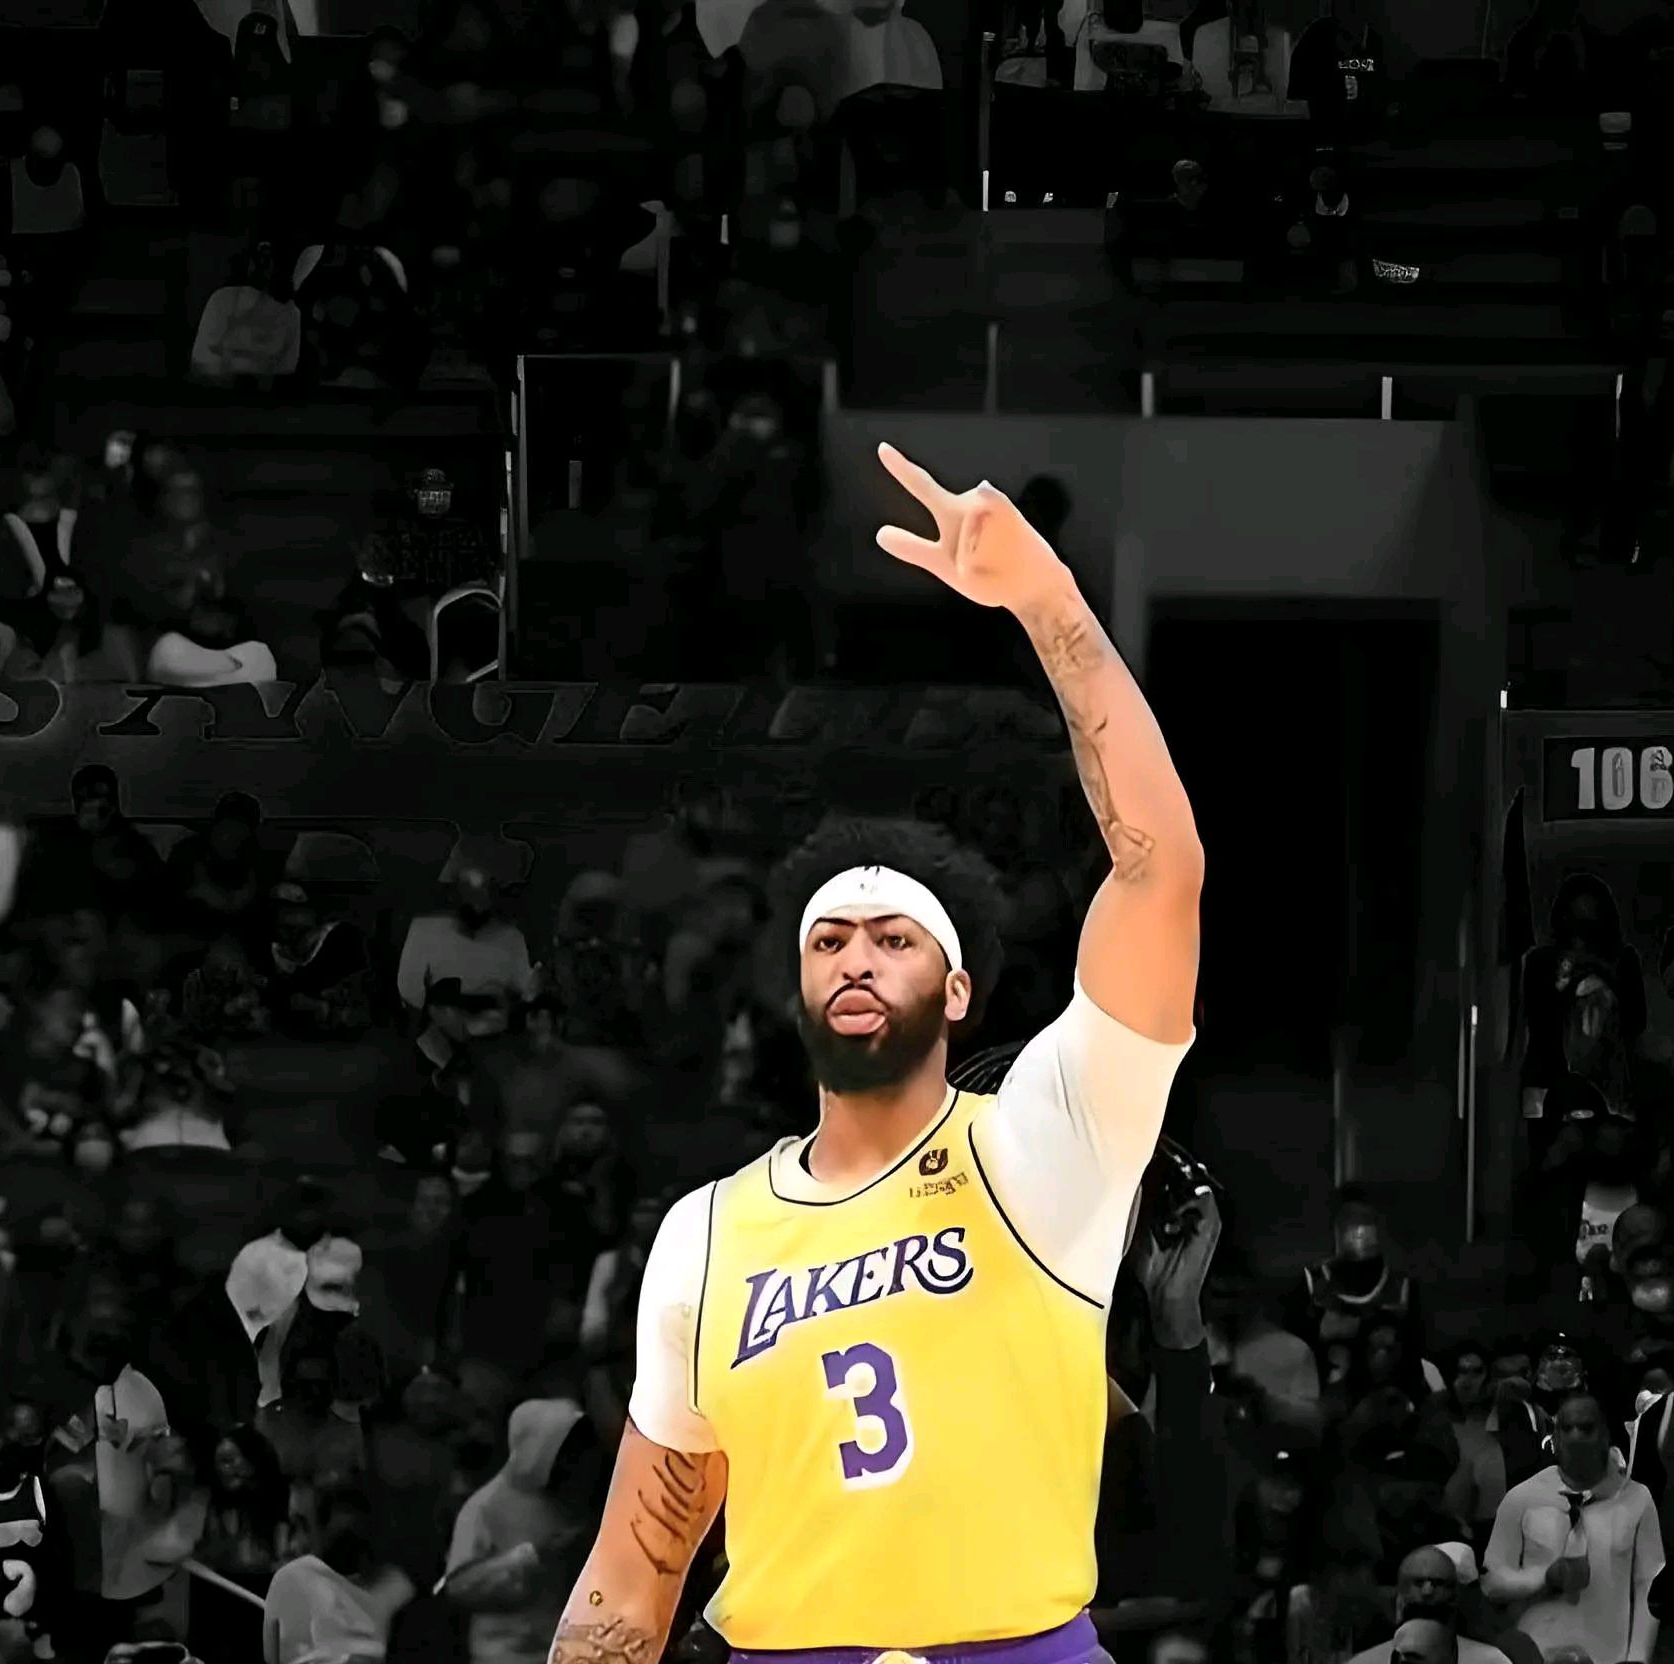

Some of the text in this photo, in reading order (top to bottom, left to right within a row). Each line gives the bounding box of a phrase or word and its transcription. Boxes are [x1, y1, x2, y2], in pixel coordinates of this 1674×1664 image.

[1571, 746, 1674, 811] 106
[730, 1227, 974, 1370] LAKERS
[821, 1341, 912, 1488] 3
